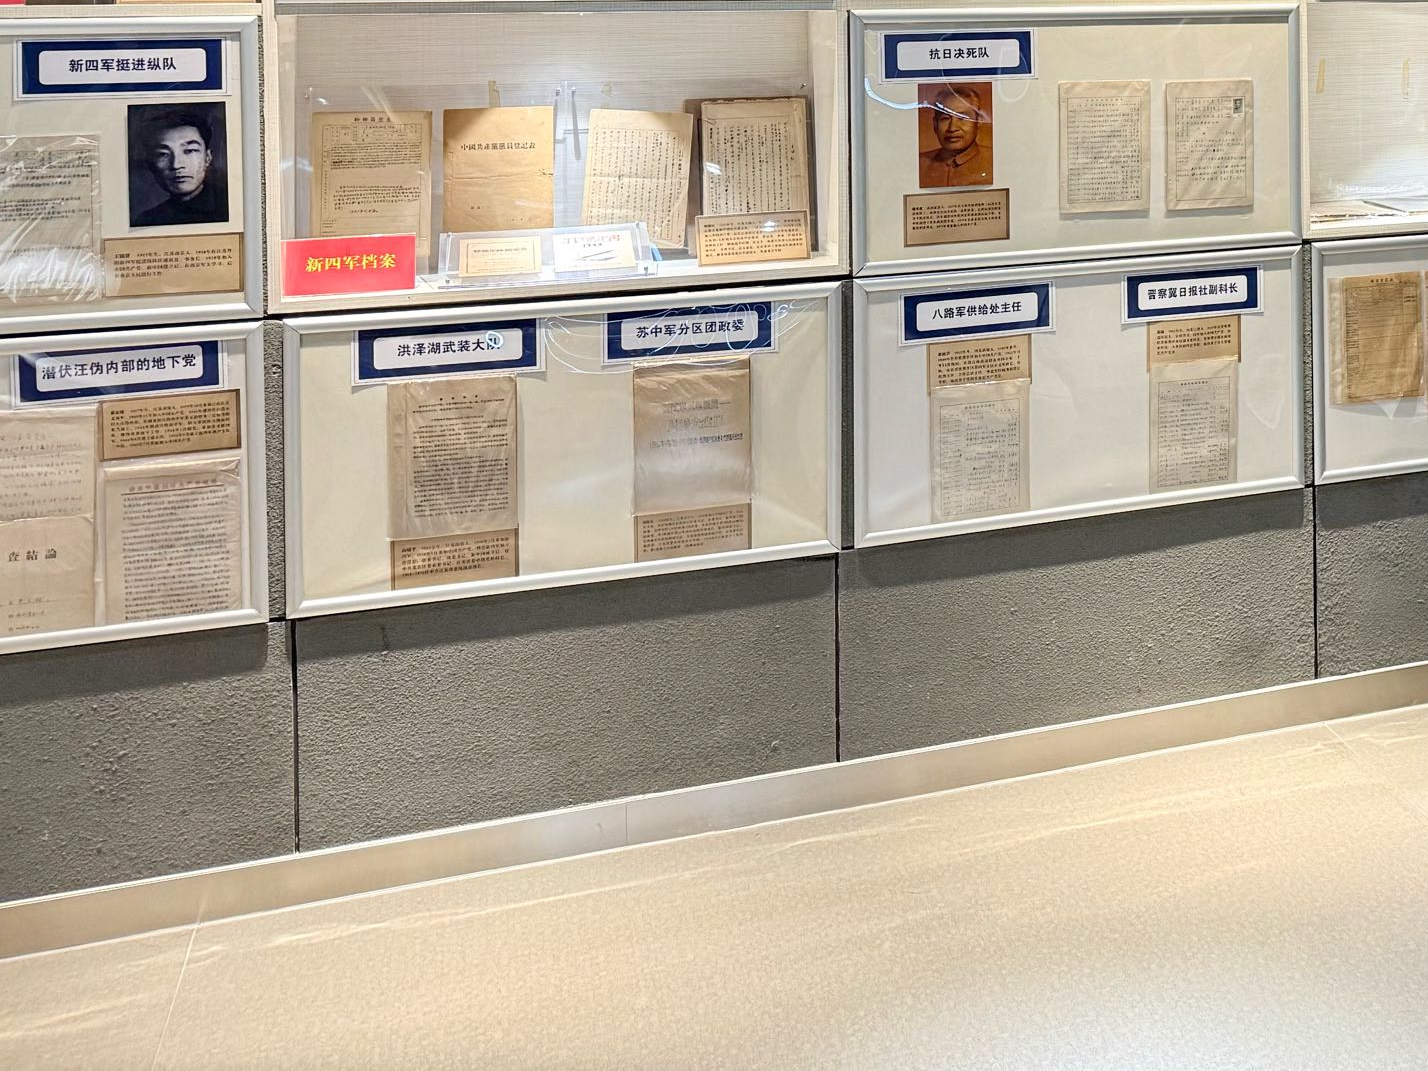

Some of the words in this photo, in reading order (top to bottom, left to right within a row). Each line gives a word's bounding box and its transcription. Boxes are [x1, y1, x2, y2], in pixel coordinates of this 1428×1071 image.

[929, 47, 990, 60] 抗日决死队
[68, 56, 177, 73] 新四军挺进纵队
[305, 253, 397, 273] 新四军档案
[1147, 282, 1238, 300] 晋察冀日报社副科长
[932, 301, 1022, 320] 八路军供给处主任
[636, 318, 745, 339] 苏中军分区团政委
[42, 353, 196, 380] 潜伏汪伪内部的地下党
